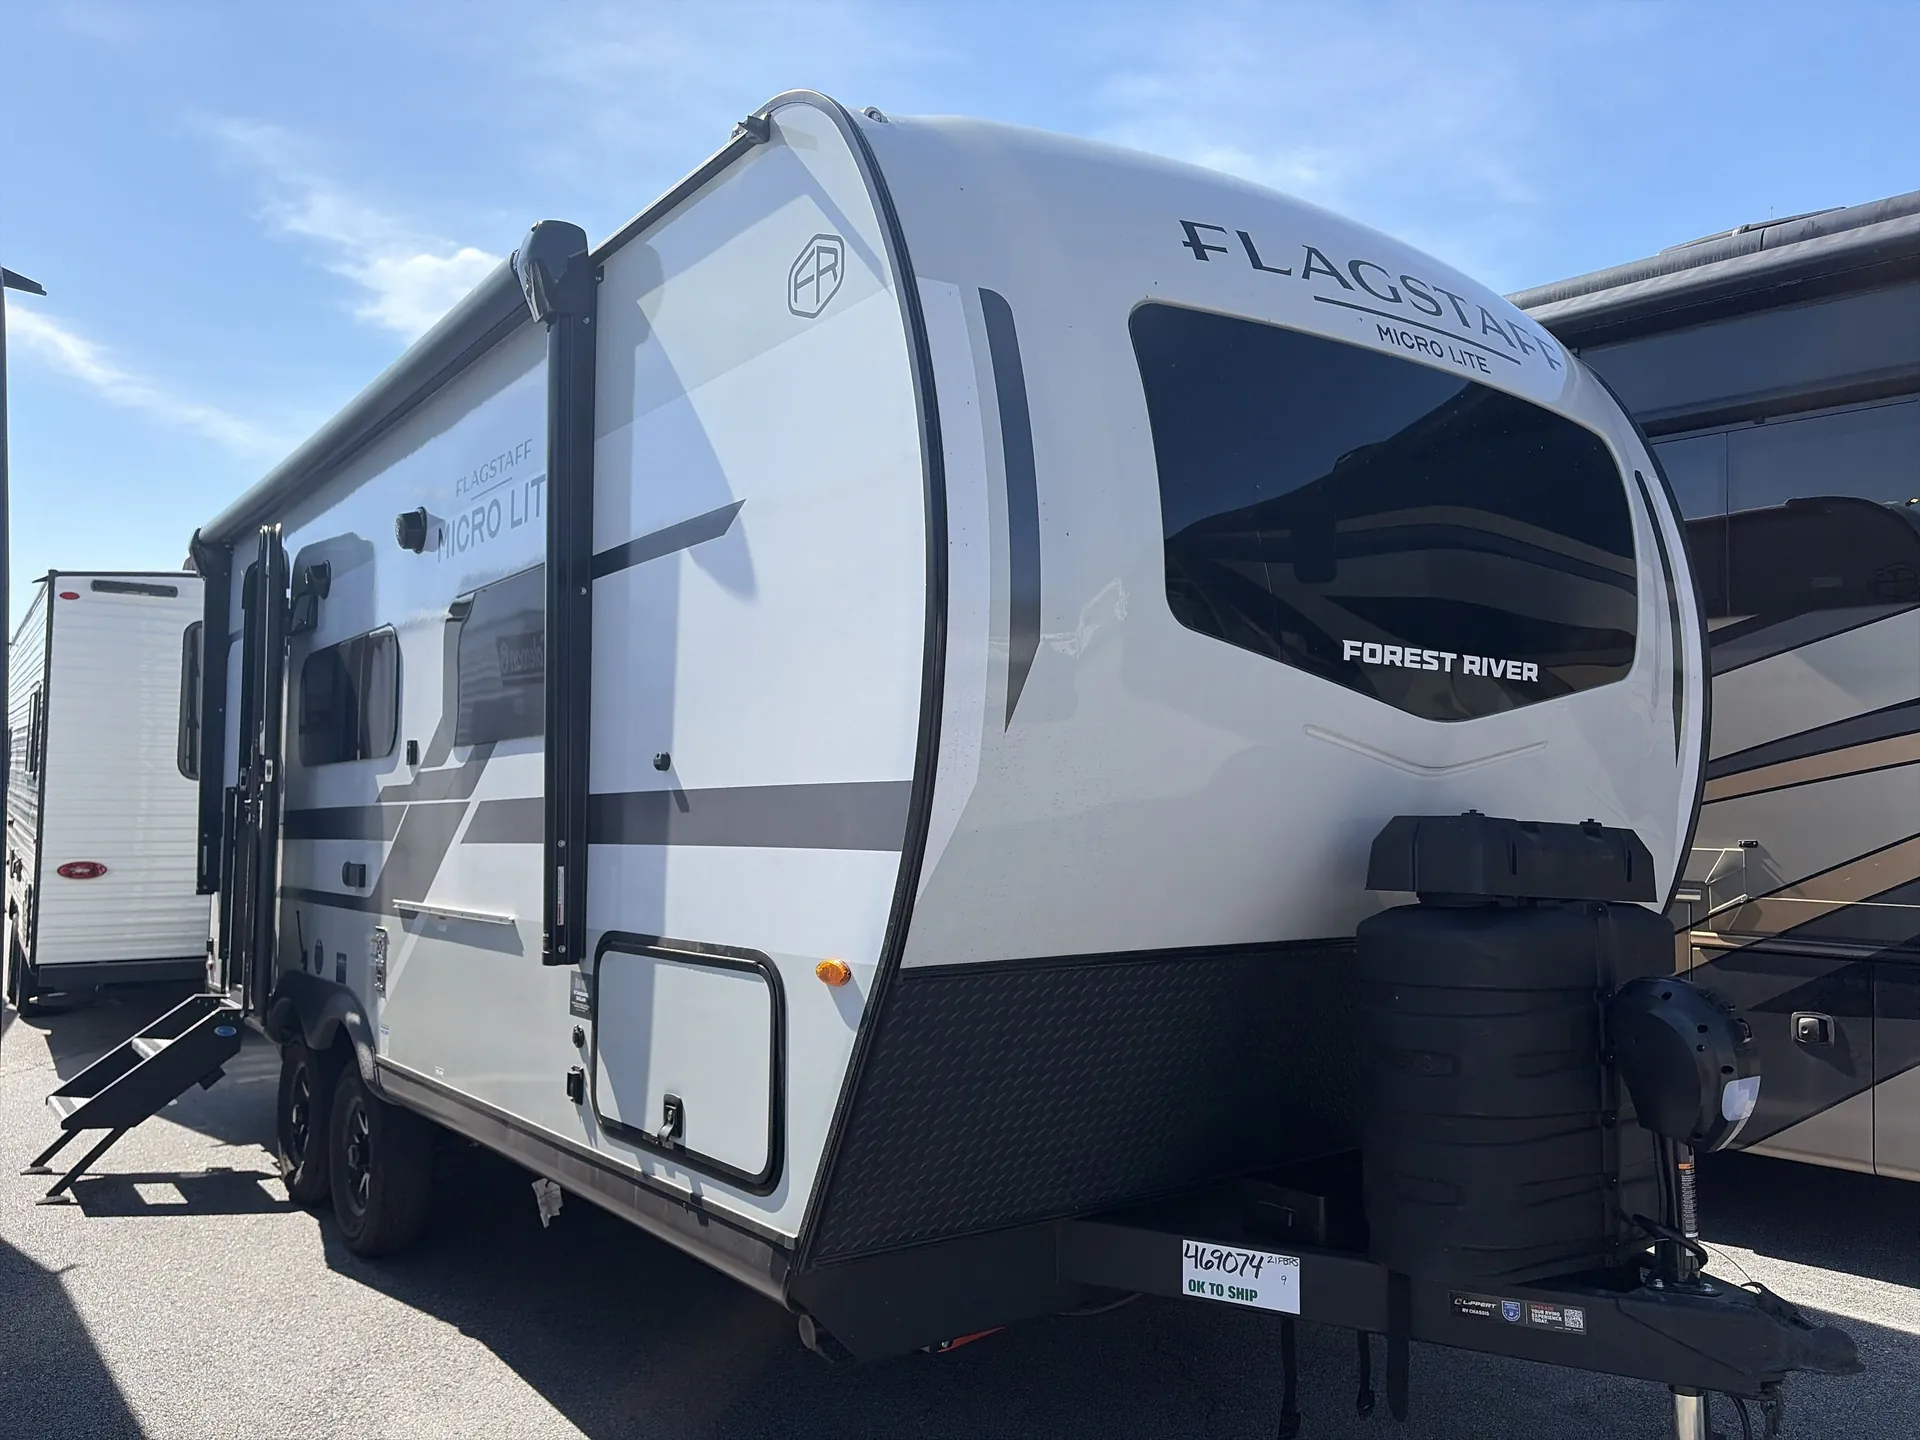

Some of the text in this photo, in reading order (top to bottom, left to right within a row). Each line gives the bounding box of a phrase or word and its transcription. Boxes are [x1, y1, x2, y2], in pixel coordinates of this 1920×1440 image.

[1179, 219, 1562, 371] FLAGSTAFF
[1376, 323, 1492, 375] MICRO LITE
[455, 438, 533, 498] FLAGSTAFF
[437, 472, 546, 563] MICRO LIT
[1341, 639, 1539, 683] FOREST RIVER
[1184, 1243, 1264, 1279] 469074
[1280, 1274, 1287, 1286] 9
[1188, 1279, 1258, 1302] OK TO SHIP
